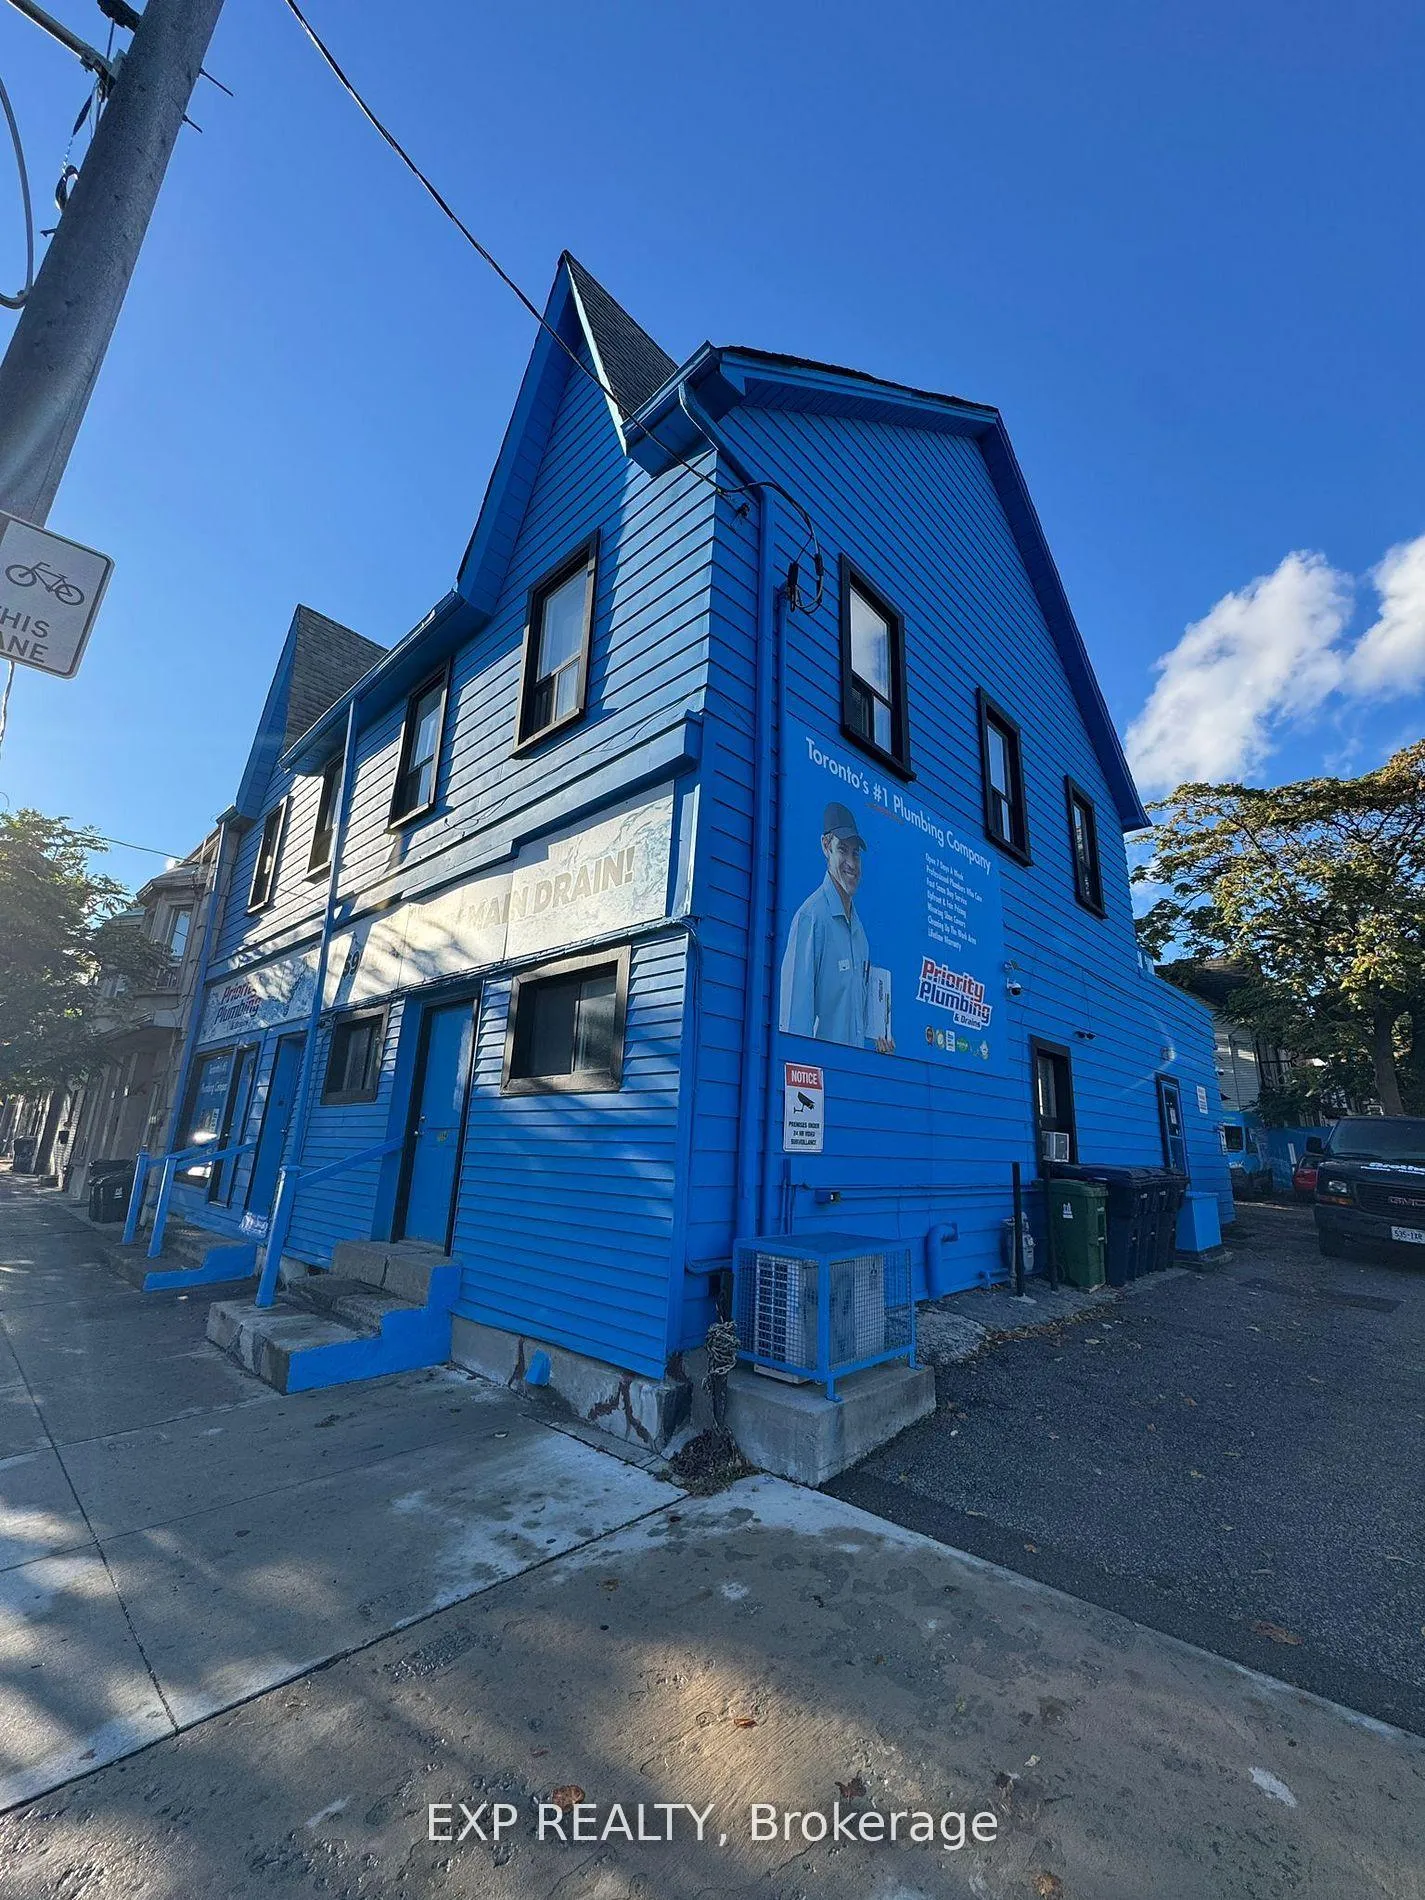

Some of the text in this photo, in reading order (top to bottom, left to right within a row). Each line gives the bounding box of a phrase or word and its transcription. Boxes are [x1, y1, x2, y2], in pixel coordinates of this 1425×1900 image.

[0, 605, 50, 638] HIS
[805, 736, 991, 875] Toronto's #1 Plumbing Company
[533, 846, 636, 914] DRAIN!
[921, 958, 984, 1002] Priority
[213, 997, 263, 1025] Plumbing
[919, 980, 992, 1025] Plumbing
[960, 1015, 981, 1028] Drains
[791, 1070, 818, 1085] NOTICE
